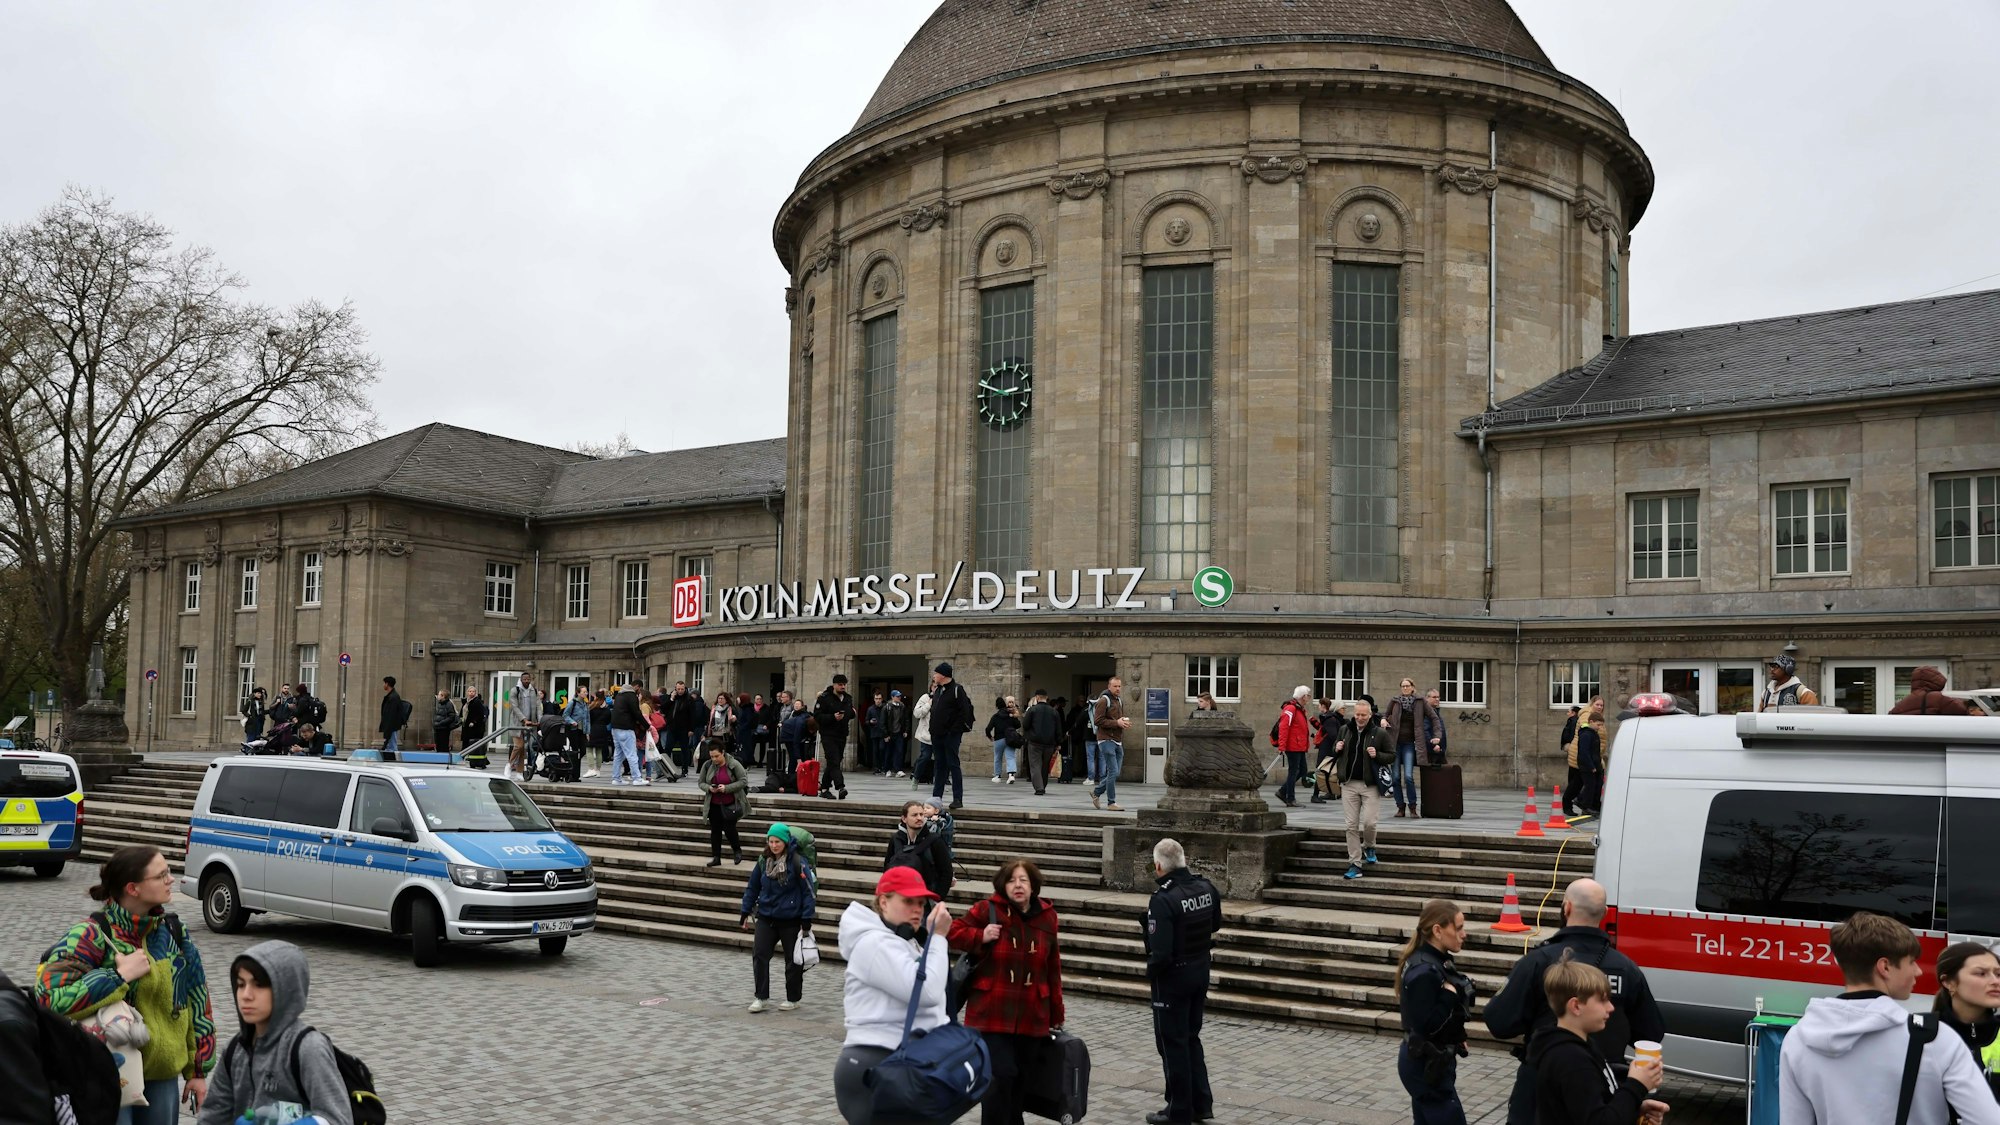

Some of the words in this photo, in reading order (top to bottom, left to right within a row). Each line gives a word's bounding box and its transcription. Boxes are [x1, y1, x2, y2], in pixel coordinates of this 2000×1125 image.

[675, 584, 698, 620] DB
[719, 581, 800, 622] KÖLN
[1200, 572, 1226, 602] S
[277, 840, 322, 860] POLIZEI
[502, 845, 566, 856] POLIZEI
[1181, 893, 1213, 913] POLIZEI
[1691, 933, 1732, 956] Tel.
[1740, 937, 1839, 965] 221-32
